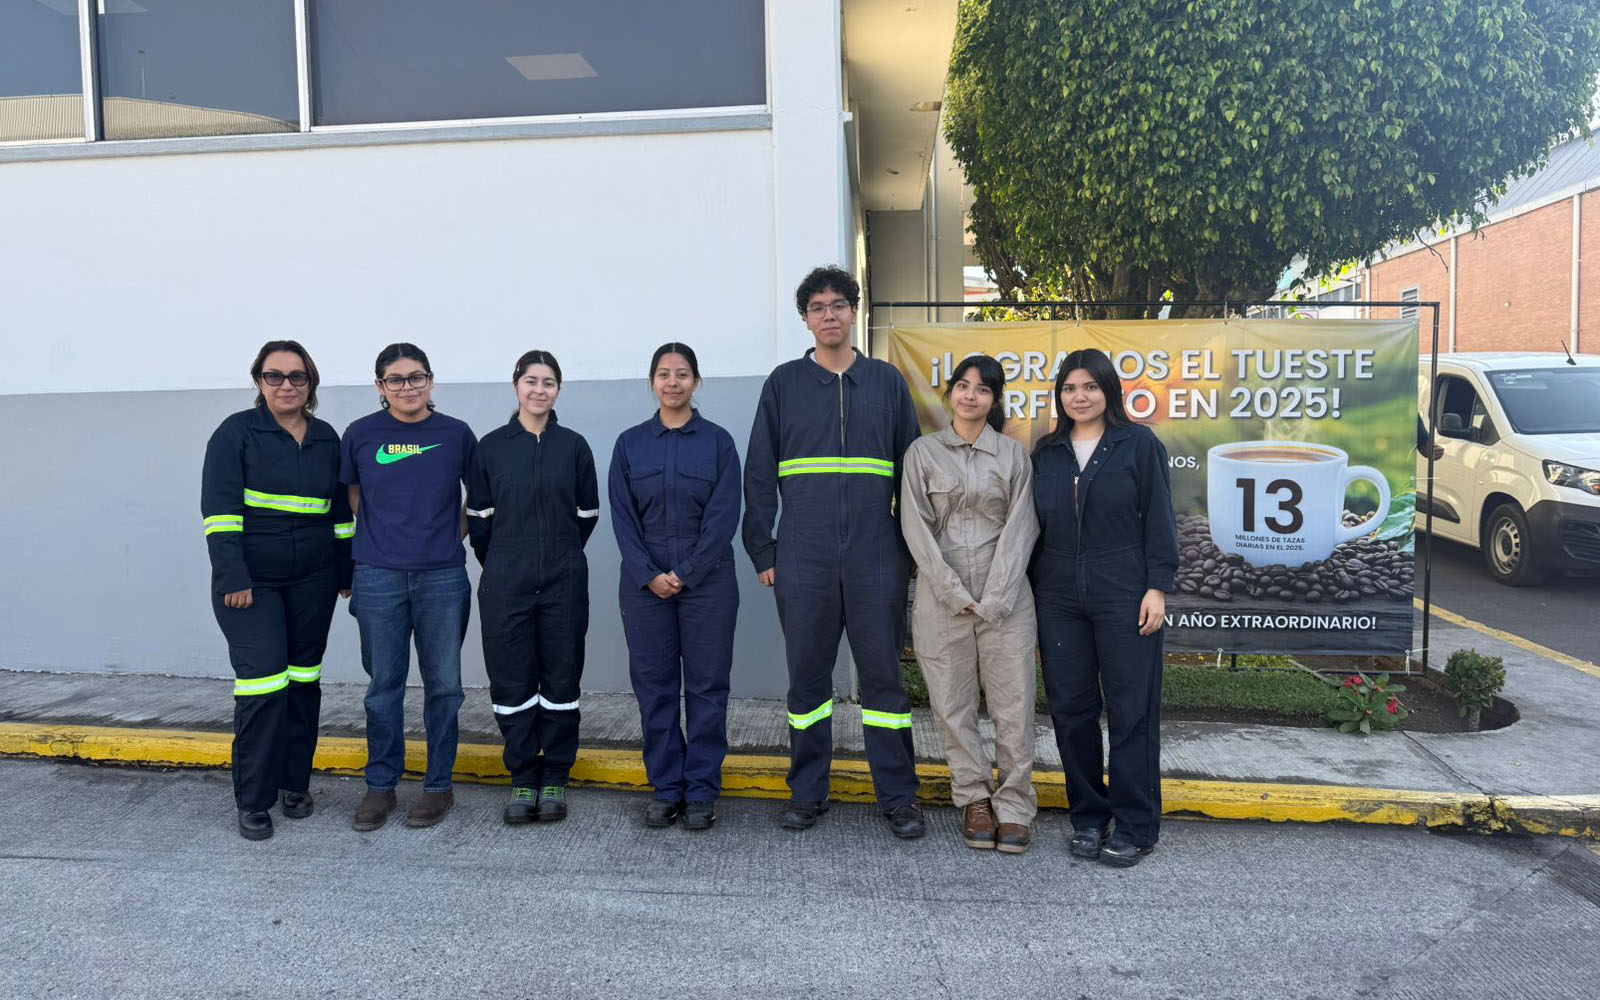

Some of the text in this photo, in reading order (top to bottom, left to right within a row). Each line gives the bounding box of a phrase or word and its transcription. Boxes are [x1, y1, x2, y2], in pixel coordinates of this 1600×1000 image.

[931, 348, 1374, 387] ¡LGRAOS EL TUESTE
[1168, 388, 1217, 418] EN
[1230, 387, 1341, 418] 2025!
[388, 444, 422, 454] BRASIL
[1236, 478, 1303, 534] 13
[1235, 534, 1270, 543] MILLONES
[1235, 541, 1264, 549] DIARIAS
[1178, 611, 1216, 628] AÑO
[1220, 614, 1376, 630] EXTRAORDINARIO!
